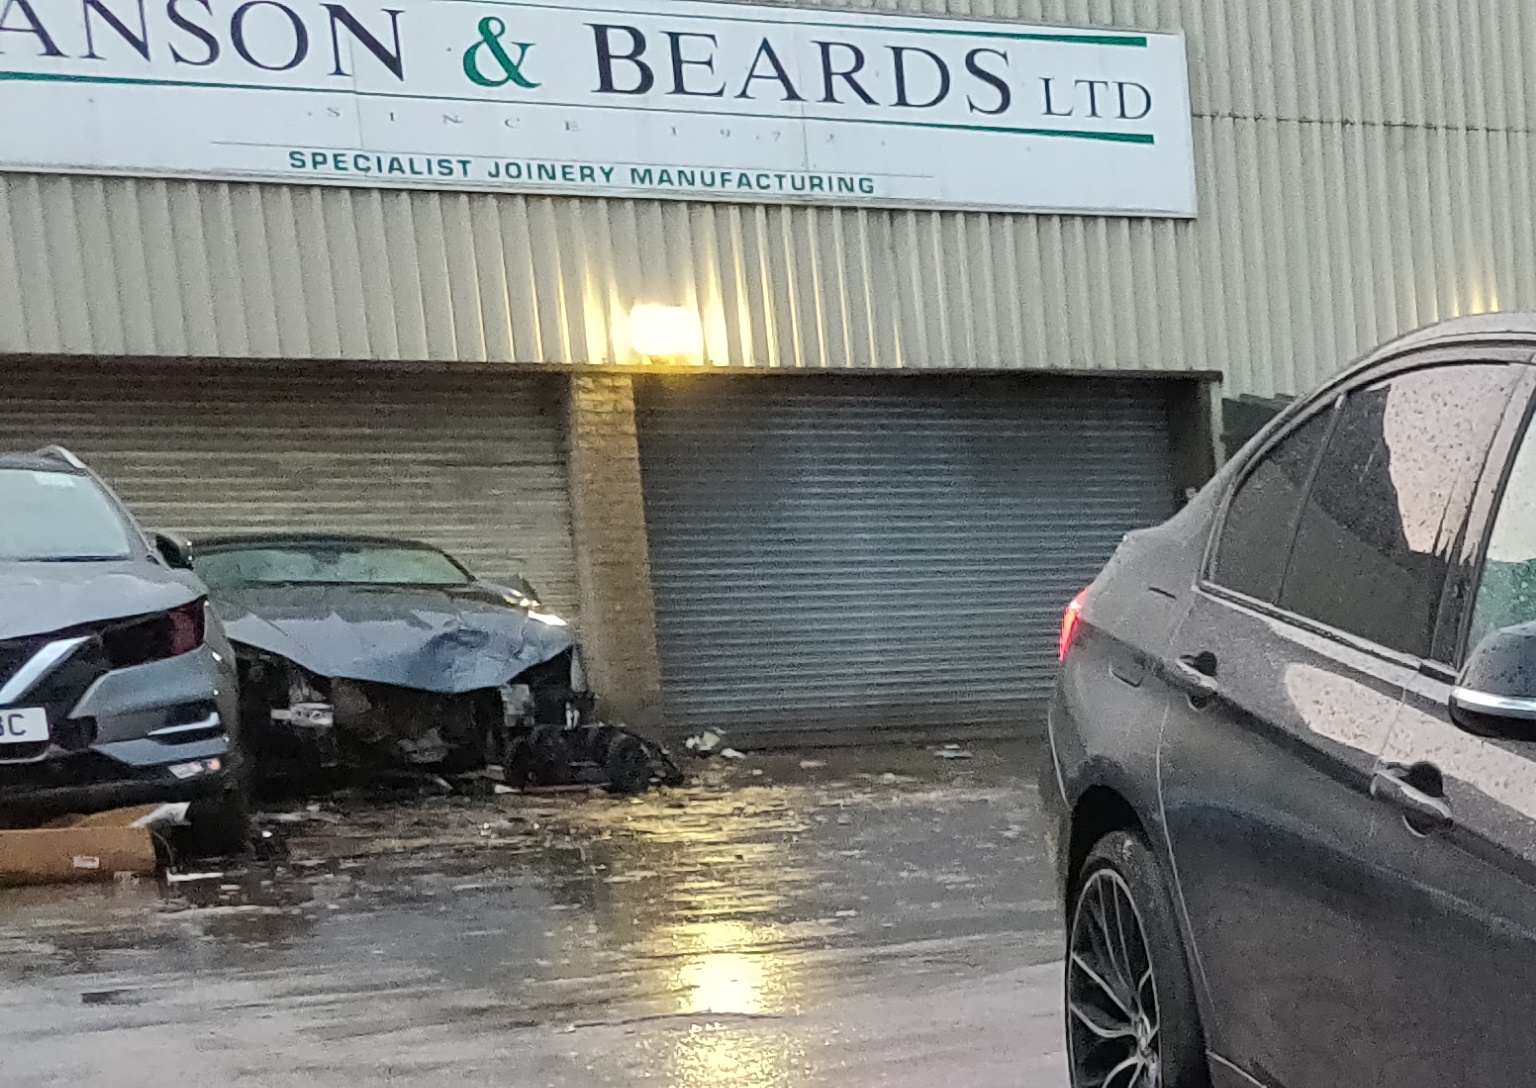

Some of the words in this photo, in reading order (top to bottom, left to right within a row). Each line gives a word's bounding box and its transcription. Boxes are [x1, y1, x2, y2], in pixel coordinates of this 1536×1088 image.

[462, 16, 542, 89] &
[582, 22, 1011, 115] BEARDS
[1038, 76, 1152, 120] LTD
[288, 150, 472, 178] SPECIALIST
[487, 161, 614, 184] JOINERY
[630, 167, 875, 194] MANUFACTURING
